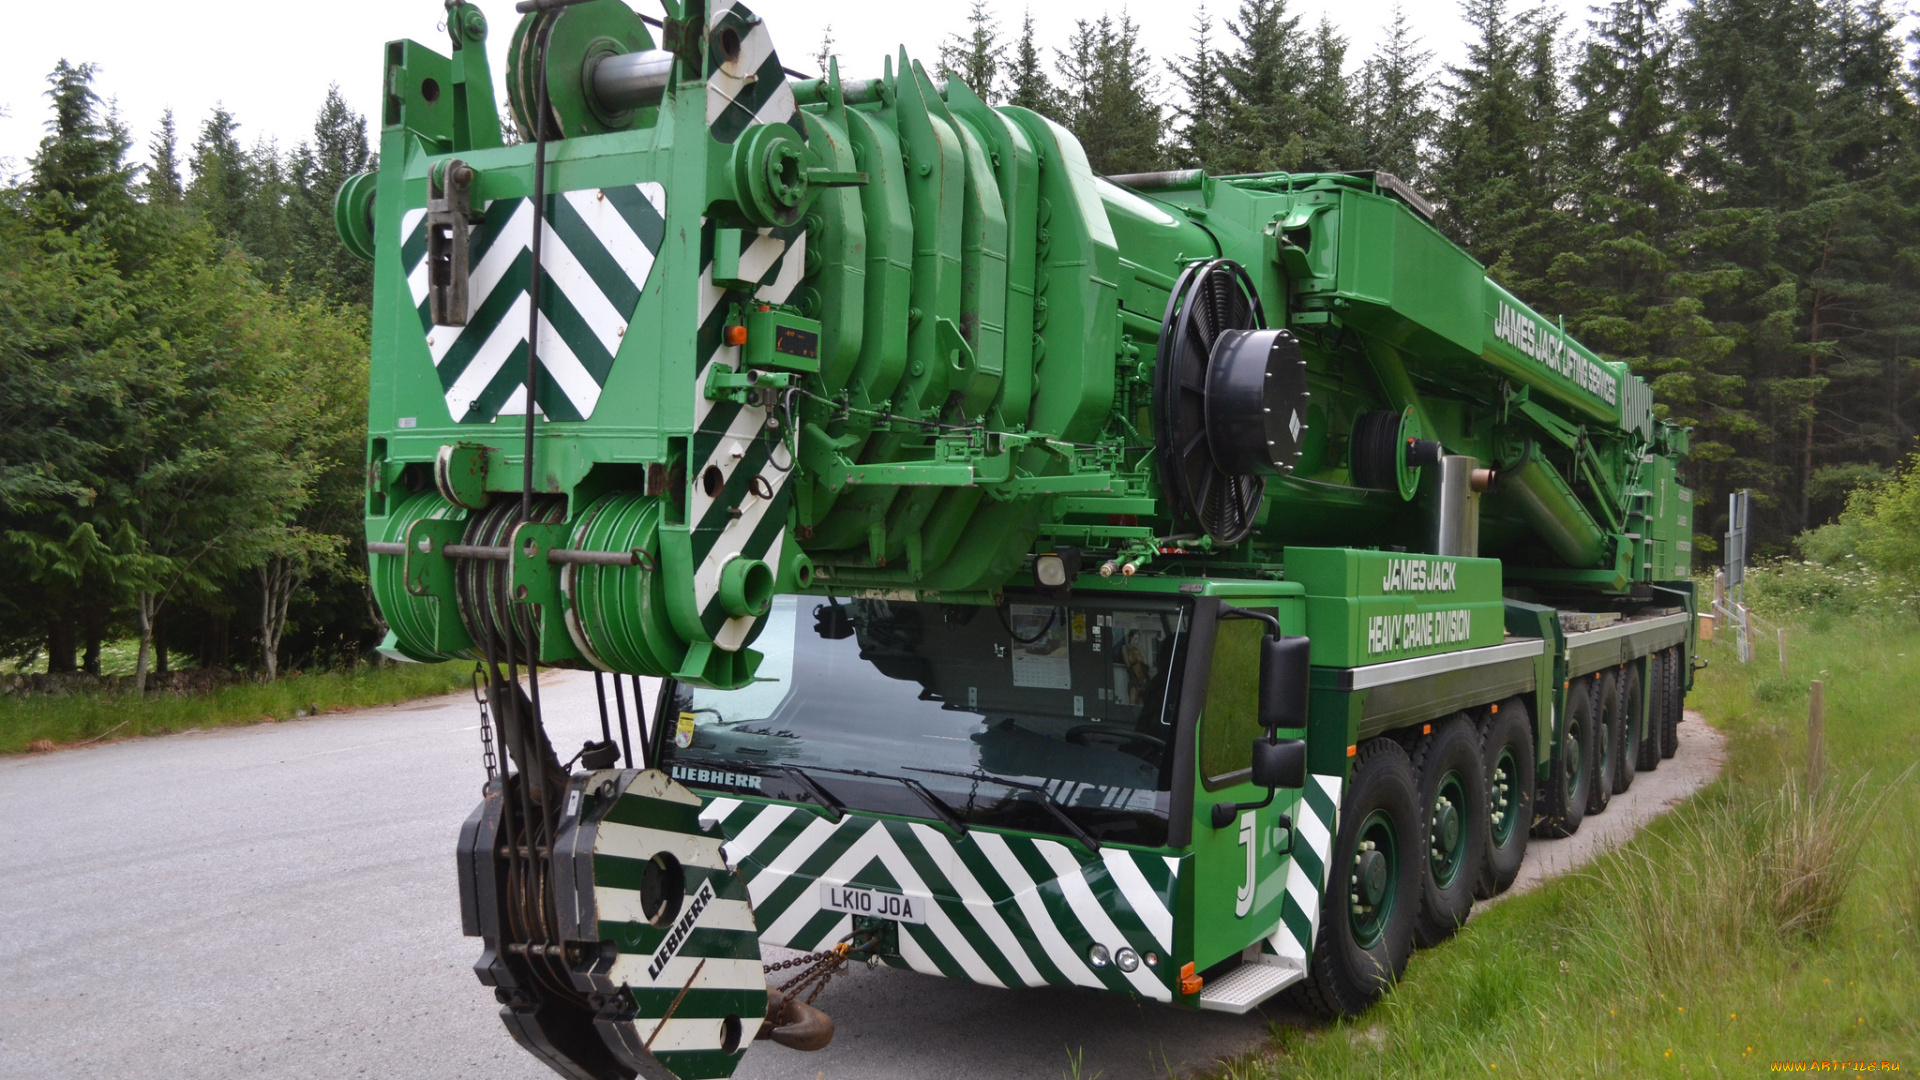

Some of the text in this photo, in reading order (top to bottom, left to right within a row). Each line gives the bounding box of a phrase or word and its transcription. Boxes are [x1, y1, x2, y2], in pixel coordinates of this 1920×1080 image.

[1494, 300, 1617, 406] JAMES JACK LIFTING SERVICES
[1383, 558, 1457, 591] JAMES JACK
[1367, 609, 1471, 654] HEAVY CRANE DIVISION
[672, 766, 762, 789] LIEBHERR
[831, 888, 913, 918] LK10 JOA
[647, 885, 713, 982] LIEBHERR
